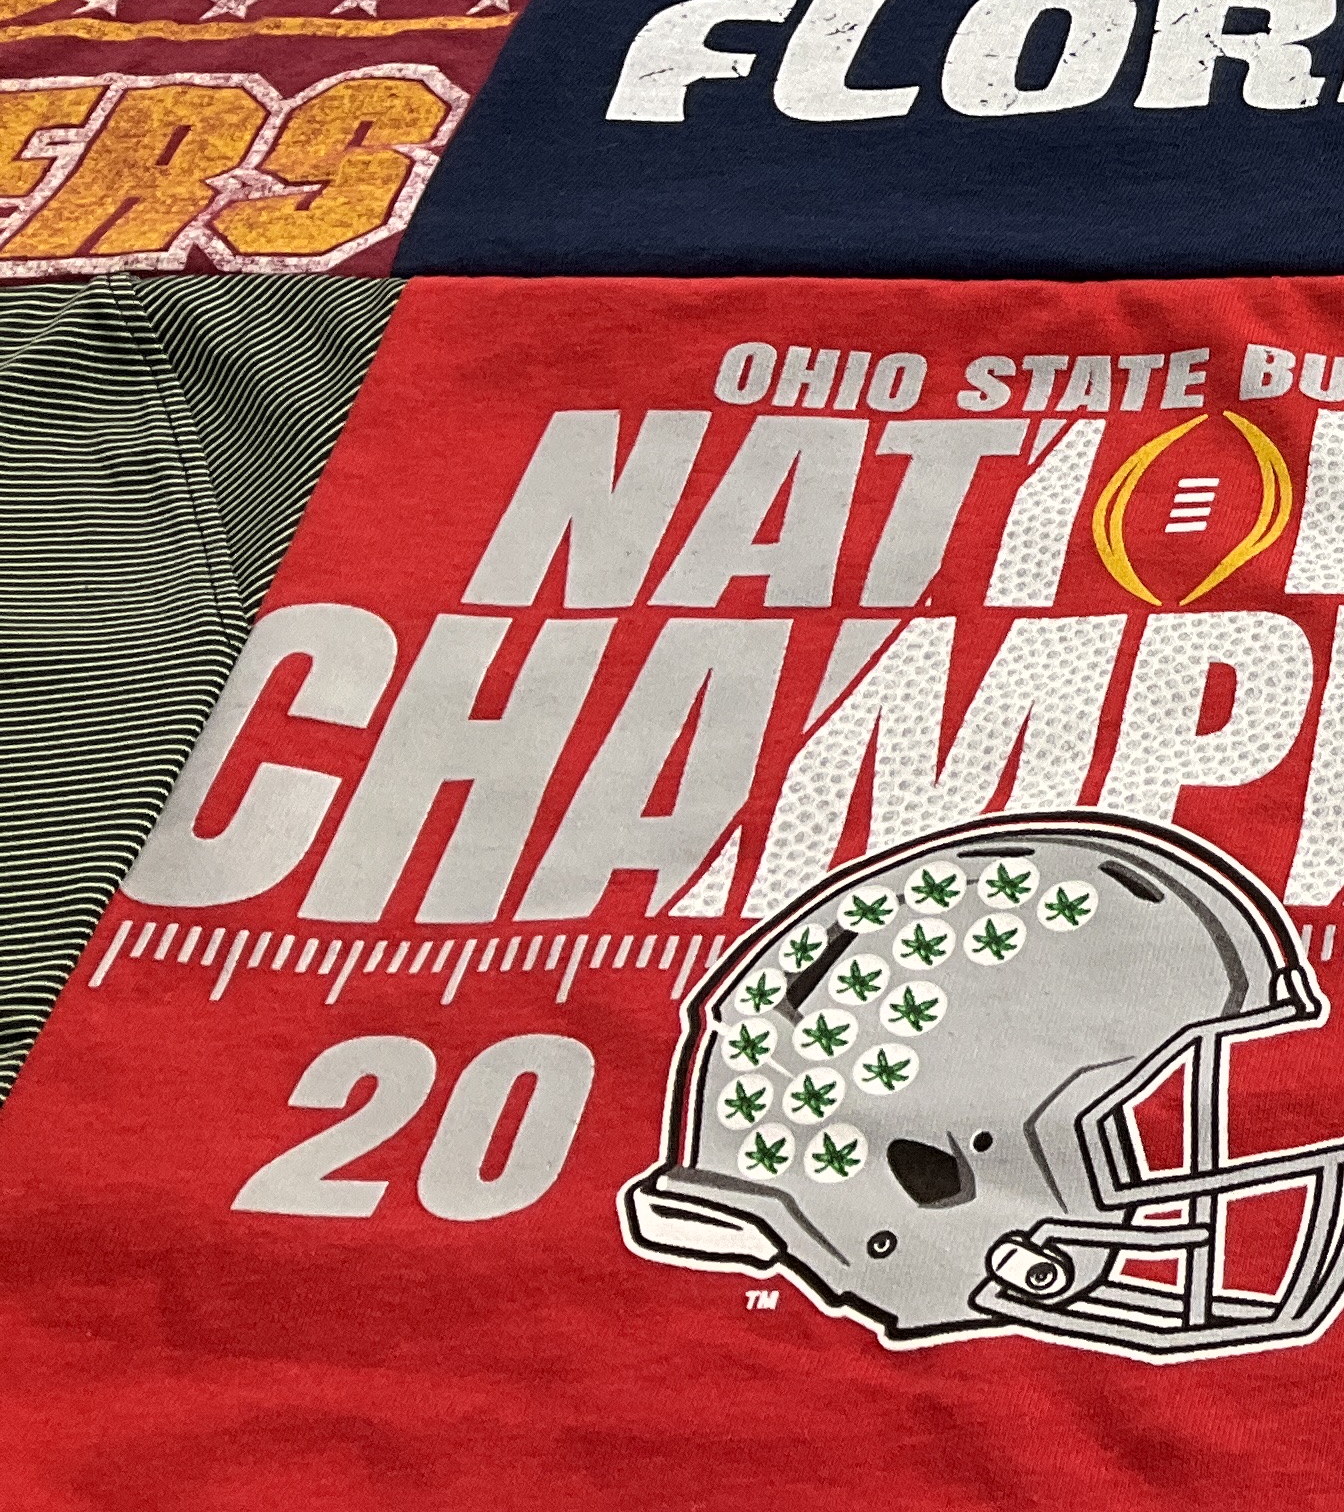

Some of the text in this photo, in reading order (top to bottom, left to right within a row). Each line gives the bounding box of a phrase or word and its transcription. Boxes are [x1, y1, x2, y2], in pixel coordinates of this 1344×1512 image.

[711, 340, 928, 412] OHIO
[954, 345, 1211, 414] STATE
[231, 1034, 598, 1223] 20
